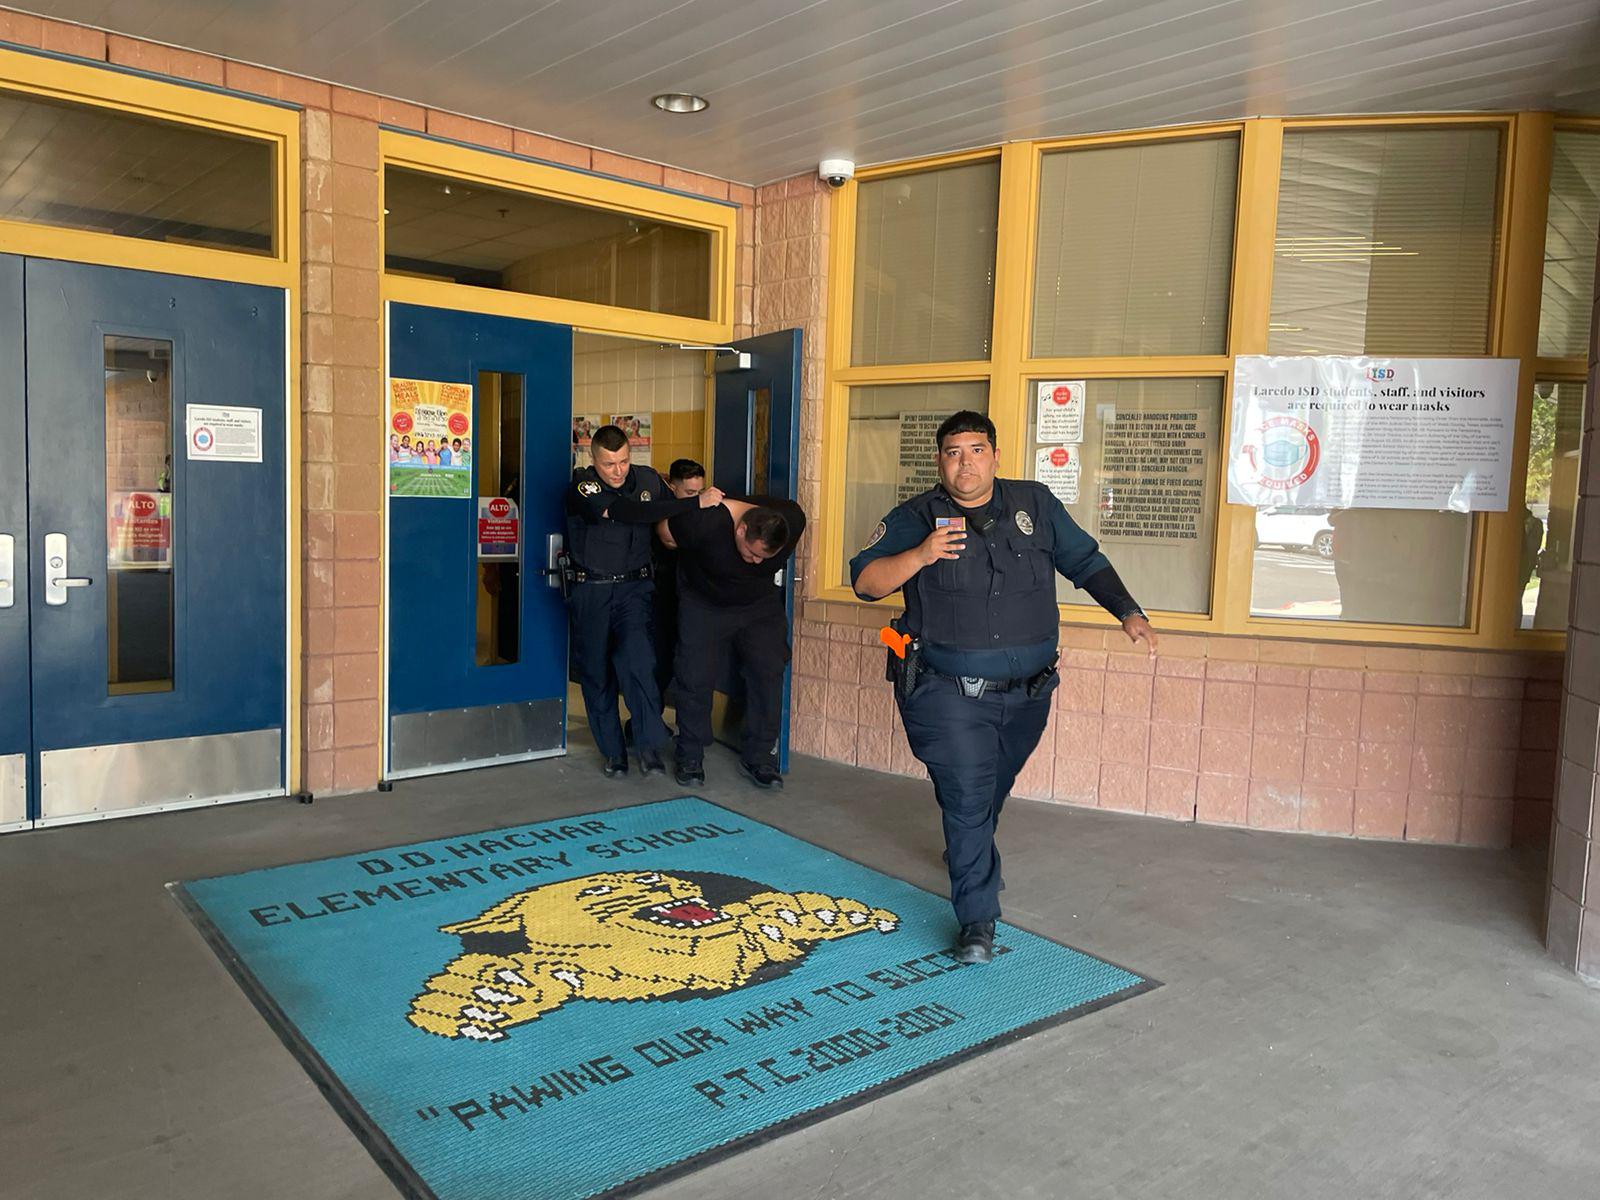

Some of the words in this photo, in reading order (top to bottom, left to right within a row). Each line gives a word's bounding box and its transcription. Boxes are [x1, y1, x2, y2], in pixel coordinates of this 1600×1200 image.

[1254, 386, 1295, 397] Laredo
[1298, 386, 1319, 397] ISD
[1324, 386, 1377, 398] students,
[1381, 386, 1410, 398] staff,
[1438, 387, 1486, 398] visitors
[1287, 402, 1306, 410] are
[1309, 401, 1365, 413] required
[1378, 402, 1409, 411] wear
[1411, 401, 1450, 412] masks
[1280, 418, 1316, 441] MASKS
[128, 500, 155, 509] ALTO
[249, 849, 574, 928] ELEMENTARY
[586, 822, 746, 860] SCHOOL
[633, 1025, 729, 1069] OUR
[725, 999, 815, 1036] WAY
[812, 979, 876, 1006] TO
